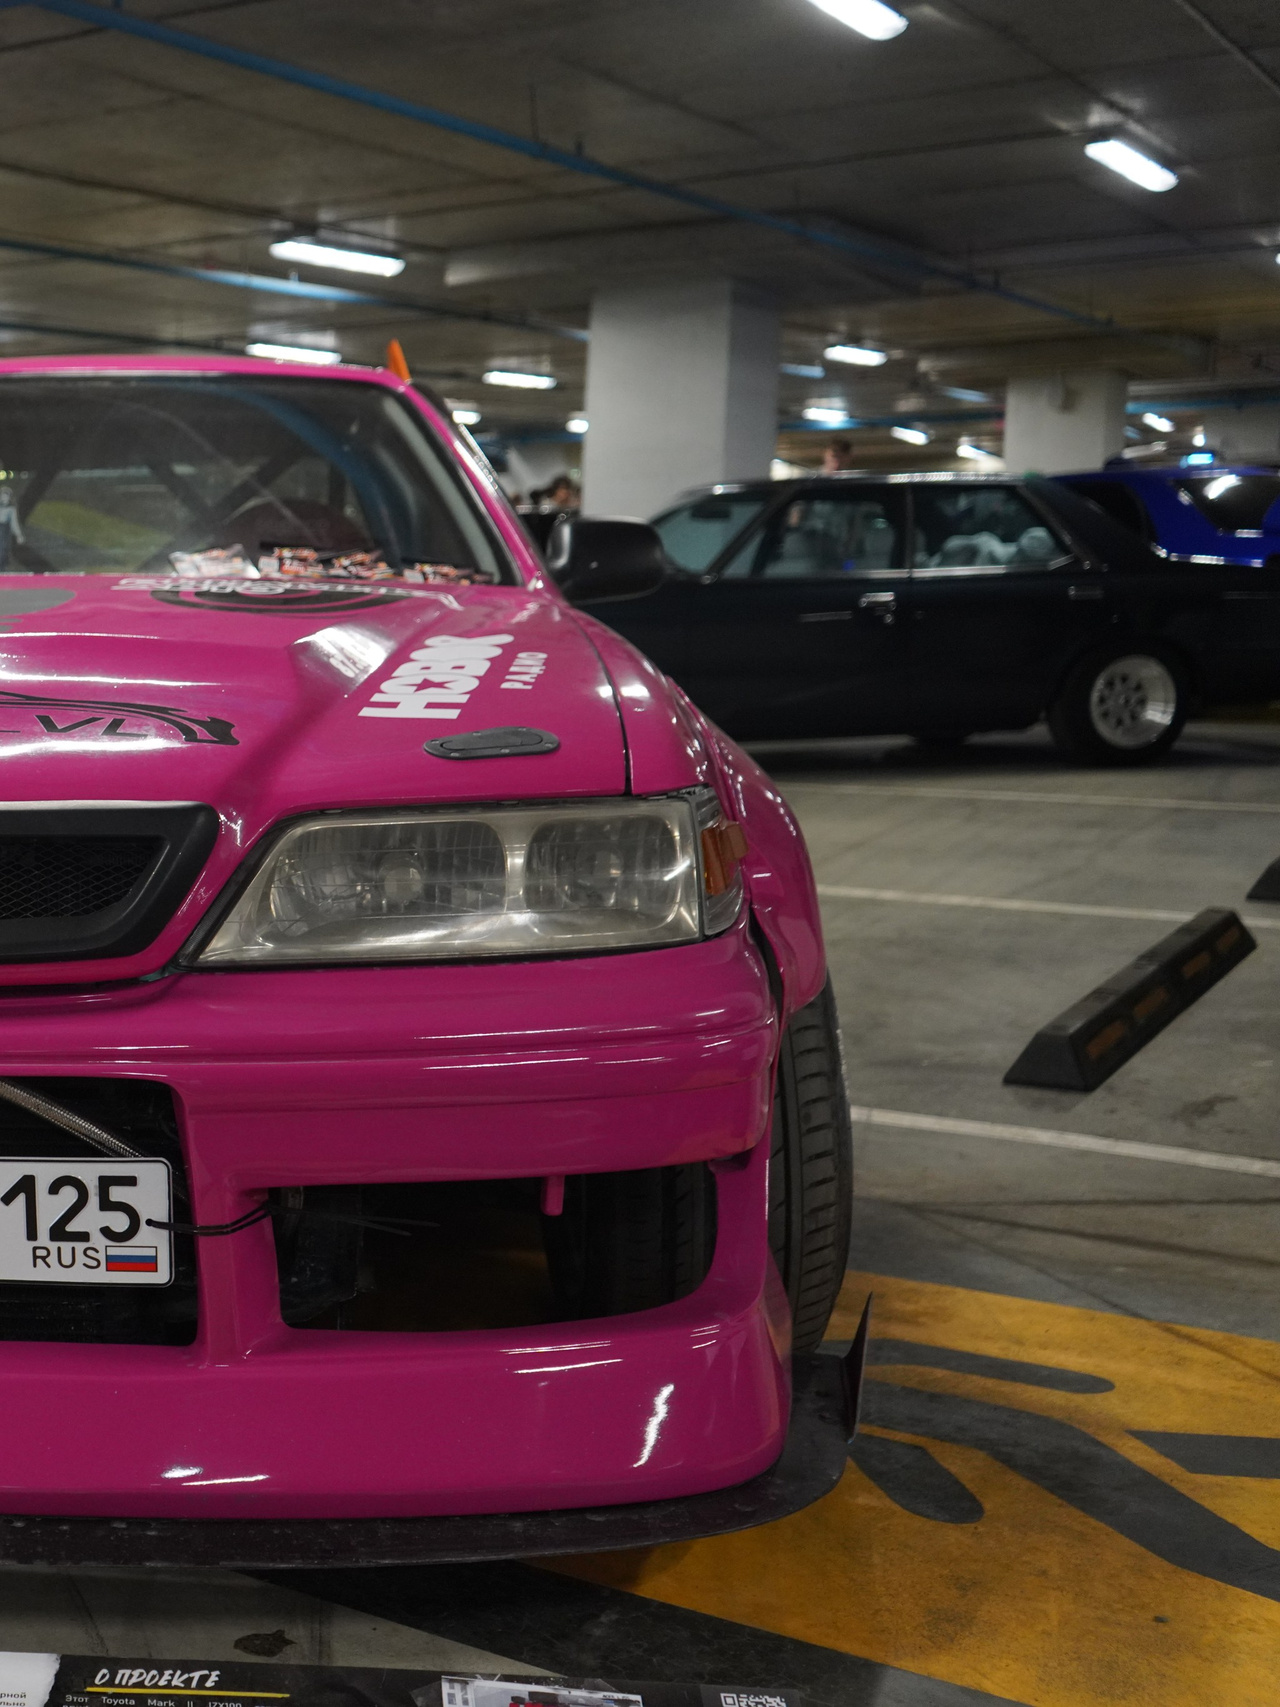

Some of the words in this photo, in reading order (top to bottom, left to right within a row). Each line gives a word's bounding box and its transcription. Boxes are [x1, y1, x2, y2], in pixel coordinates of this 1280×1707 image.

[500, 651, 548, 689] РАДИО
[0, 1173, 141, 1243] 125
[32, 1245, 102, 1269] RUS
[94, 1668, 110, 1686] О
[115, 1669, 221, 1689] ПРОЕКТЕ
[65, 1694, 89, 1703] Этот
[101, 1696, 135, 1706] Toyota
[147, 1698, 175, 1707] Mark
